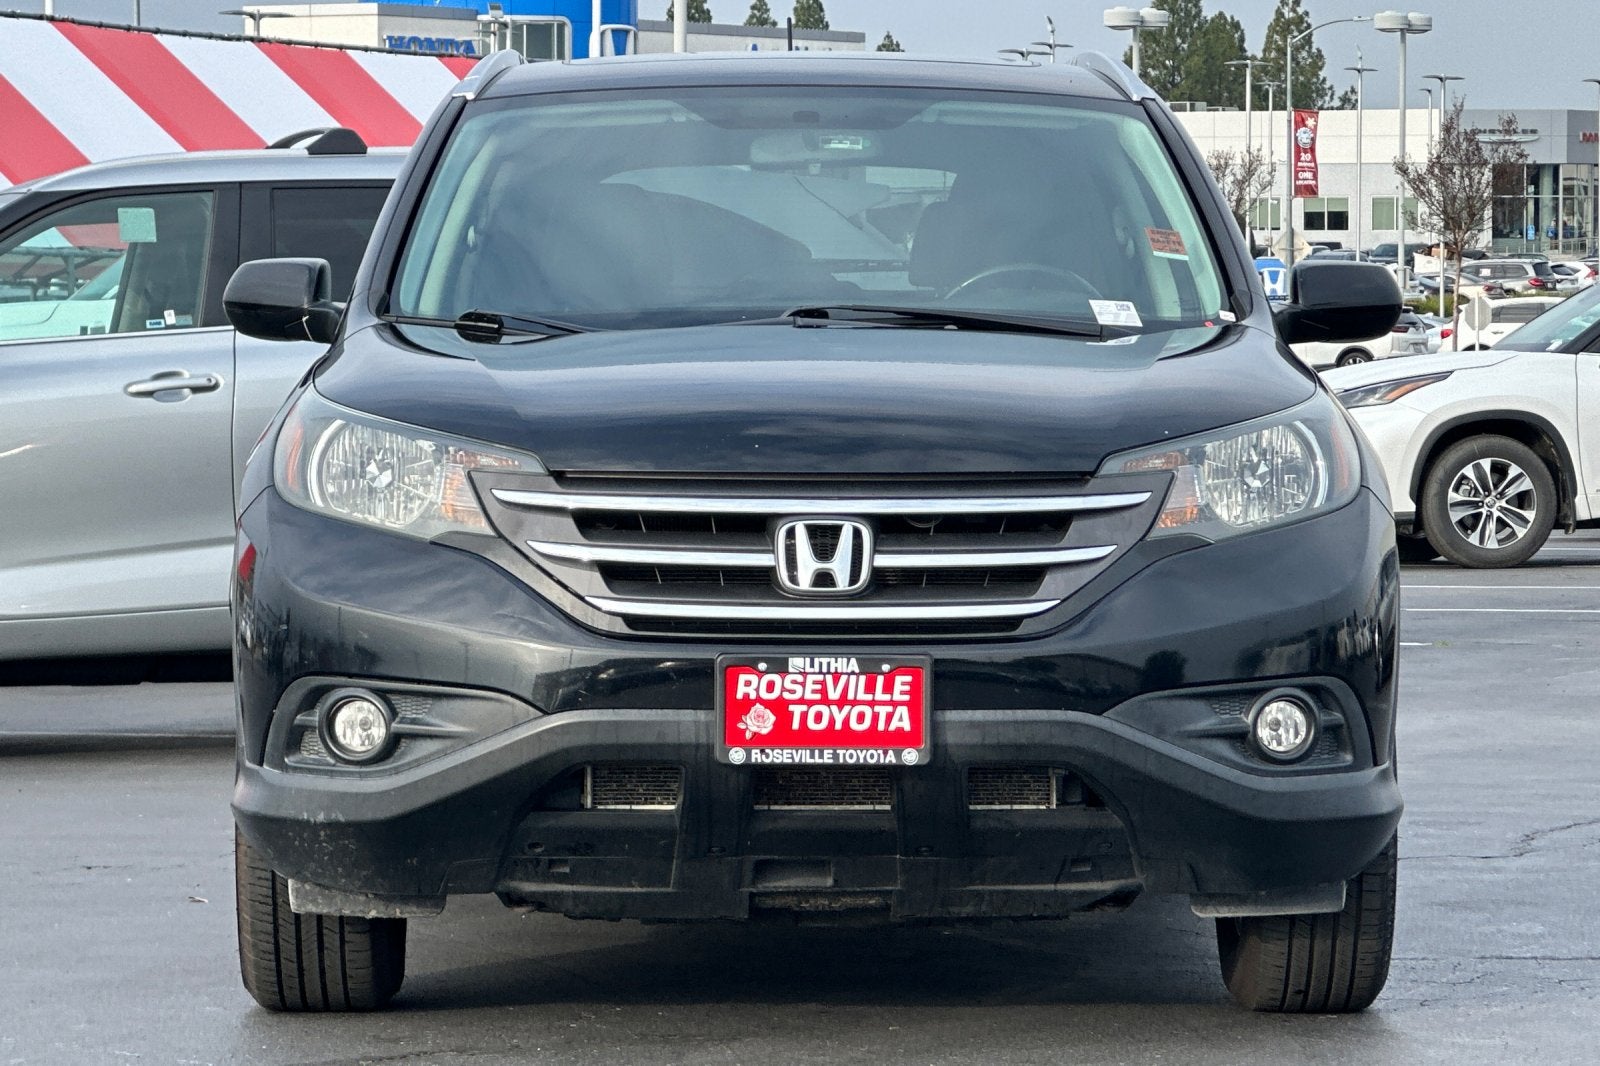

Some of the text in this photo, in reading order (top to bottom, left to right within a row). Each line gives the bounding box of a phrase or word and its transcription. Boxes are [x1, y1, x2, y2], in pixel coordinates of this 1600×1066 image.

[386, 35, 477, 54] HONDA
[1299, 152, 1312, 162] 20
[805, 657, 859, 673] LITHIA
[735, 673, 913, 702] ROSEVILLE
[787, 704, 912, 732] TOYOTA
[751, 748, 896, 764] ROSEVILLE TOYOTA
